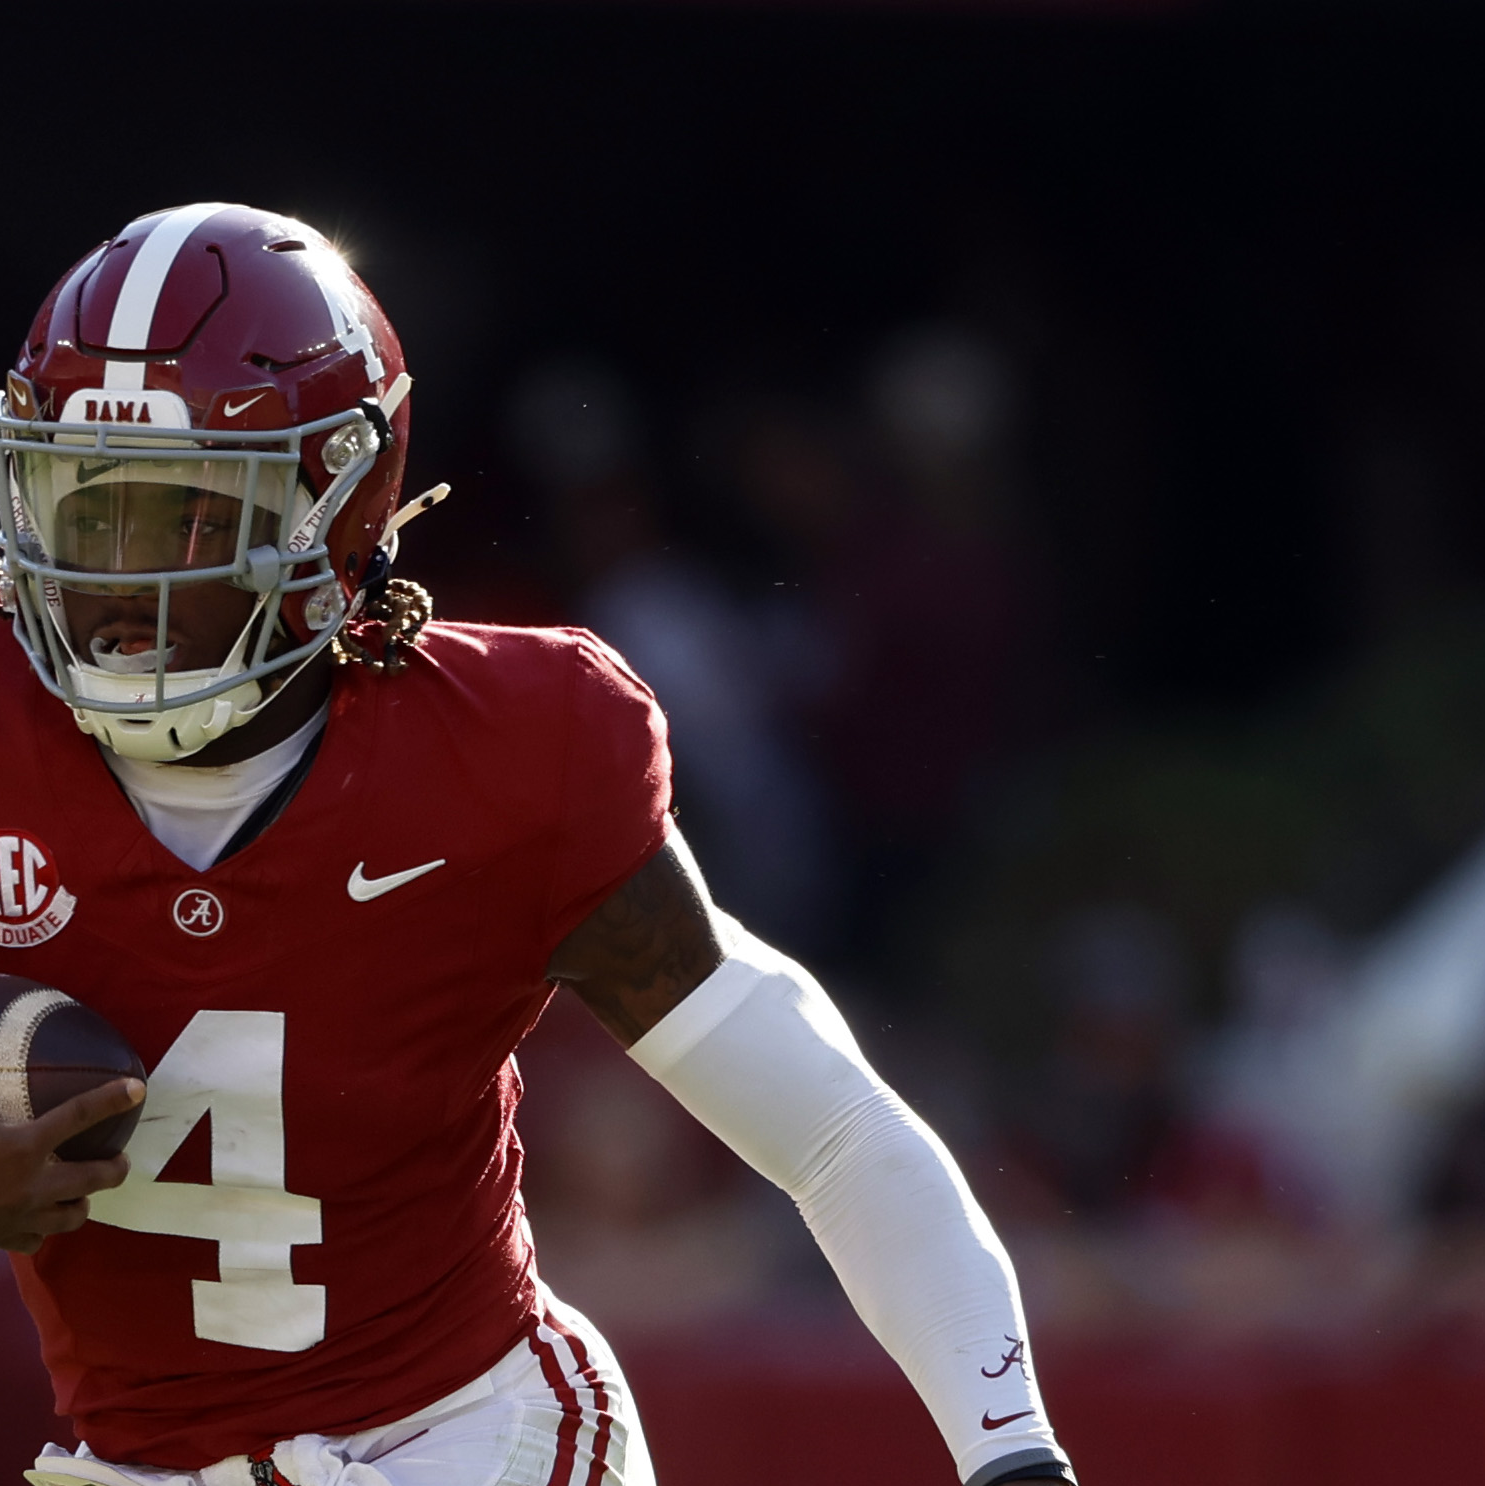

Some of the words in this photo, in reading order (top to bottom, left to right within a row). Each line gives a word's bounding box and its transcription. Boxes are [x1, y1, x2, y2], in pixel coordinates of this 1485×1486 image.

[85, 400, 152, 423] BAMA
[181, 896, 212, 926] A
[87, 1010, 326, 1352] 4
[981, 1334, 1031, 1380] A
